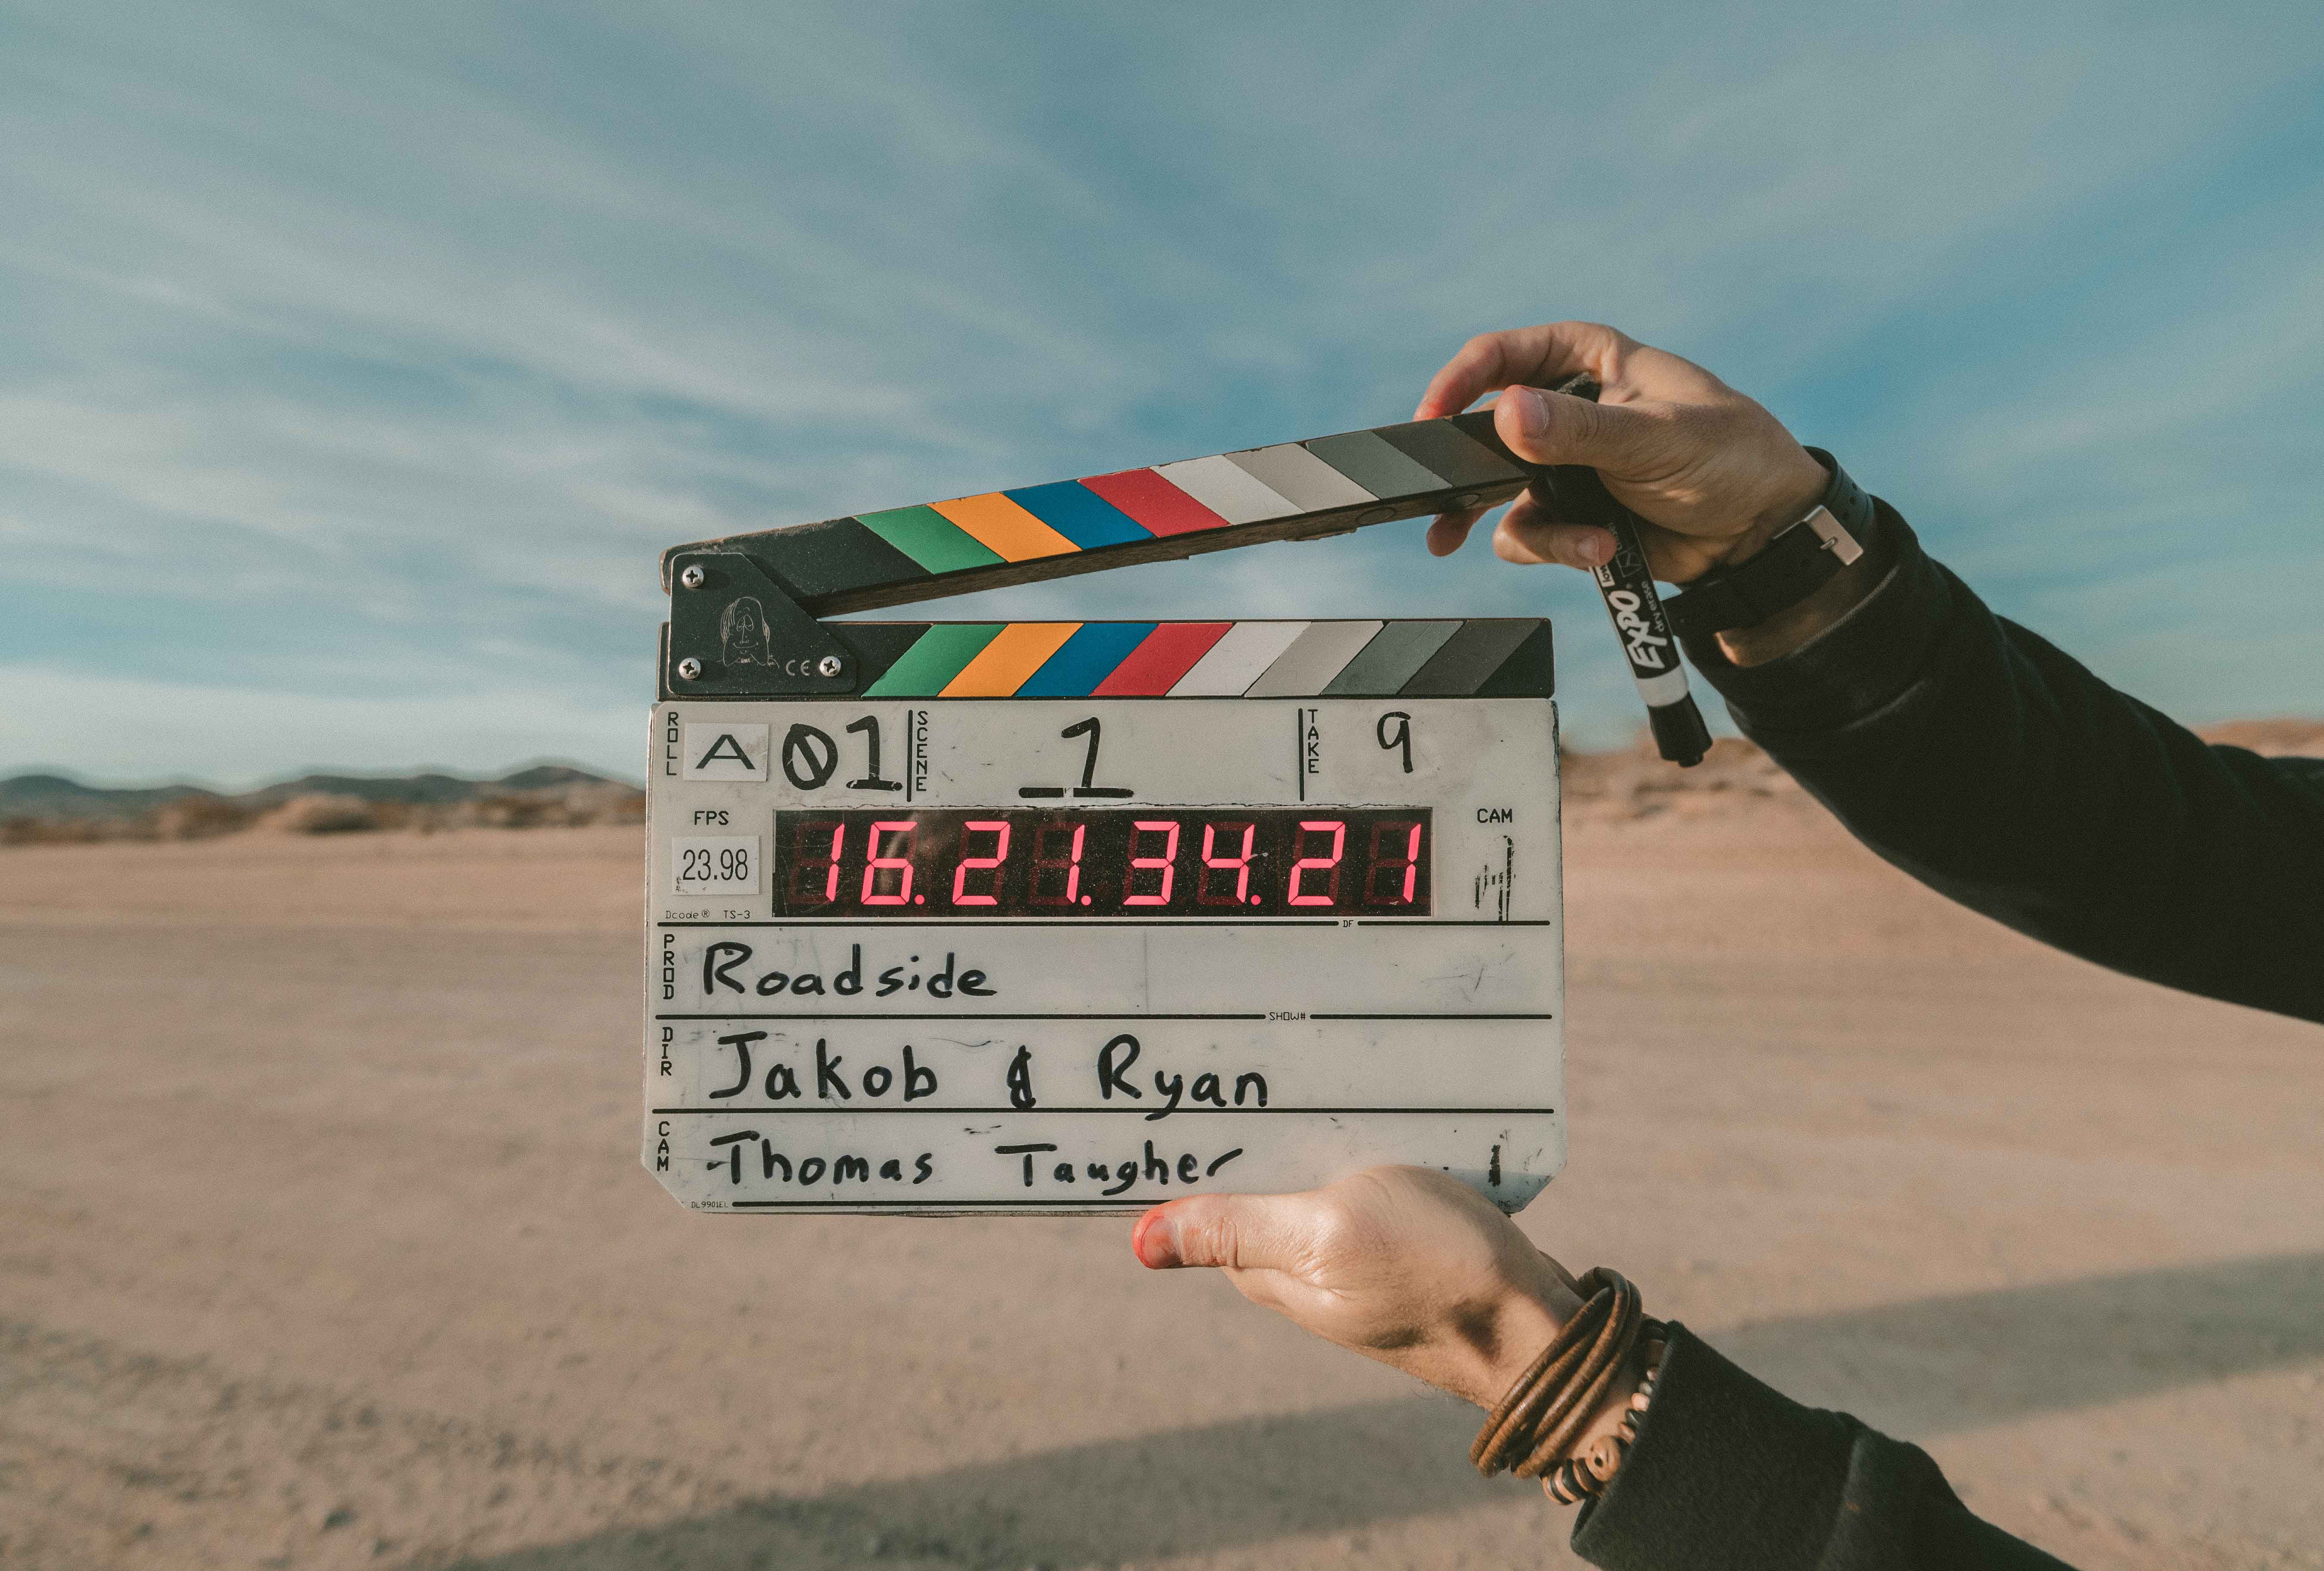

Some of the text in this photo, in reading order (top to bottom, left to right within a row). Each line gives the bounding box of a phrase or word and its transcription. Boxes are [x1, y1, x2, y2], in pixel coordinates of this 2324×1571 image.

[1608, 590, 1668, 670] EXPO
[666, 712, 679, 776] ROLL
[695, 734, 756, 770] A
[916, 711, 928, 792] SCENE
[1308, 709, 1319, 773] TAKE
[1377, 711, 1413, 773] 9
[694, 810, 729, 826] FPS
[1477, 808, 1513, 823] CAM
[682, 849, 748, 881] 23.98
[723, 910, 750, 919] TS-3
[663, 934, 675, 1000] PROD
[703, 941, 998, 998] Roadside
[1269, 1012, 1306, 1021] SHOW#
[660, 1027, 673, 1076] DIR
[709, 1031, 938, 1102] Jakob
[1097, 1034, 1268, 1121] Ryan
[657, 1121, 670, 1172] CAM
[706, 1130, 1243, 1196] Thomas Taugher
